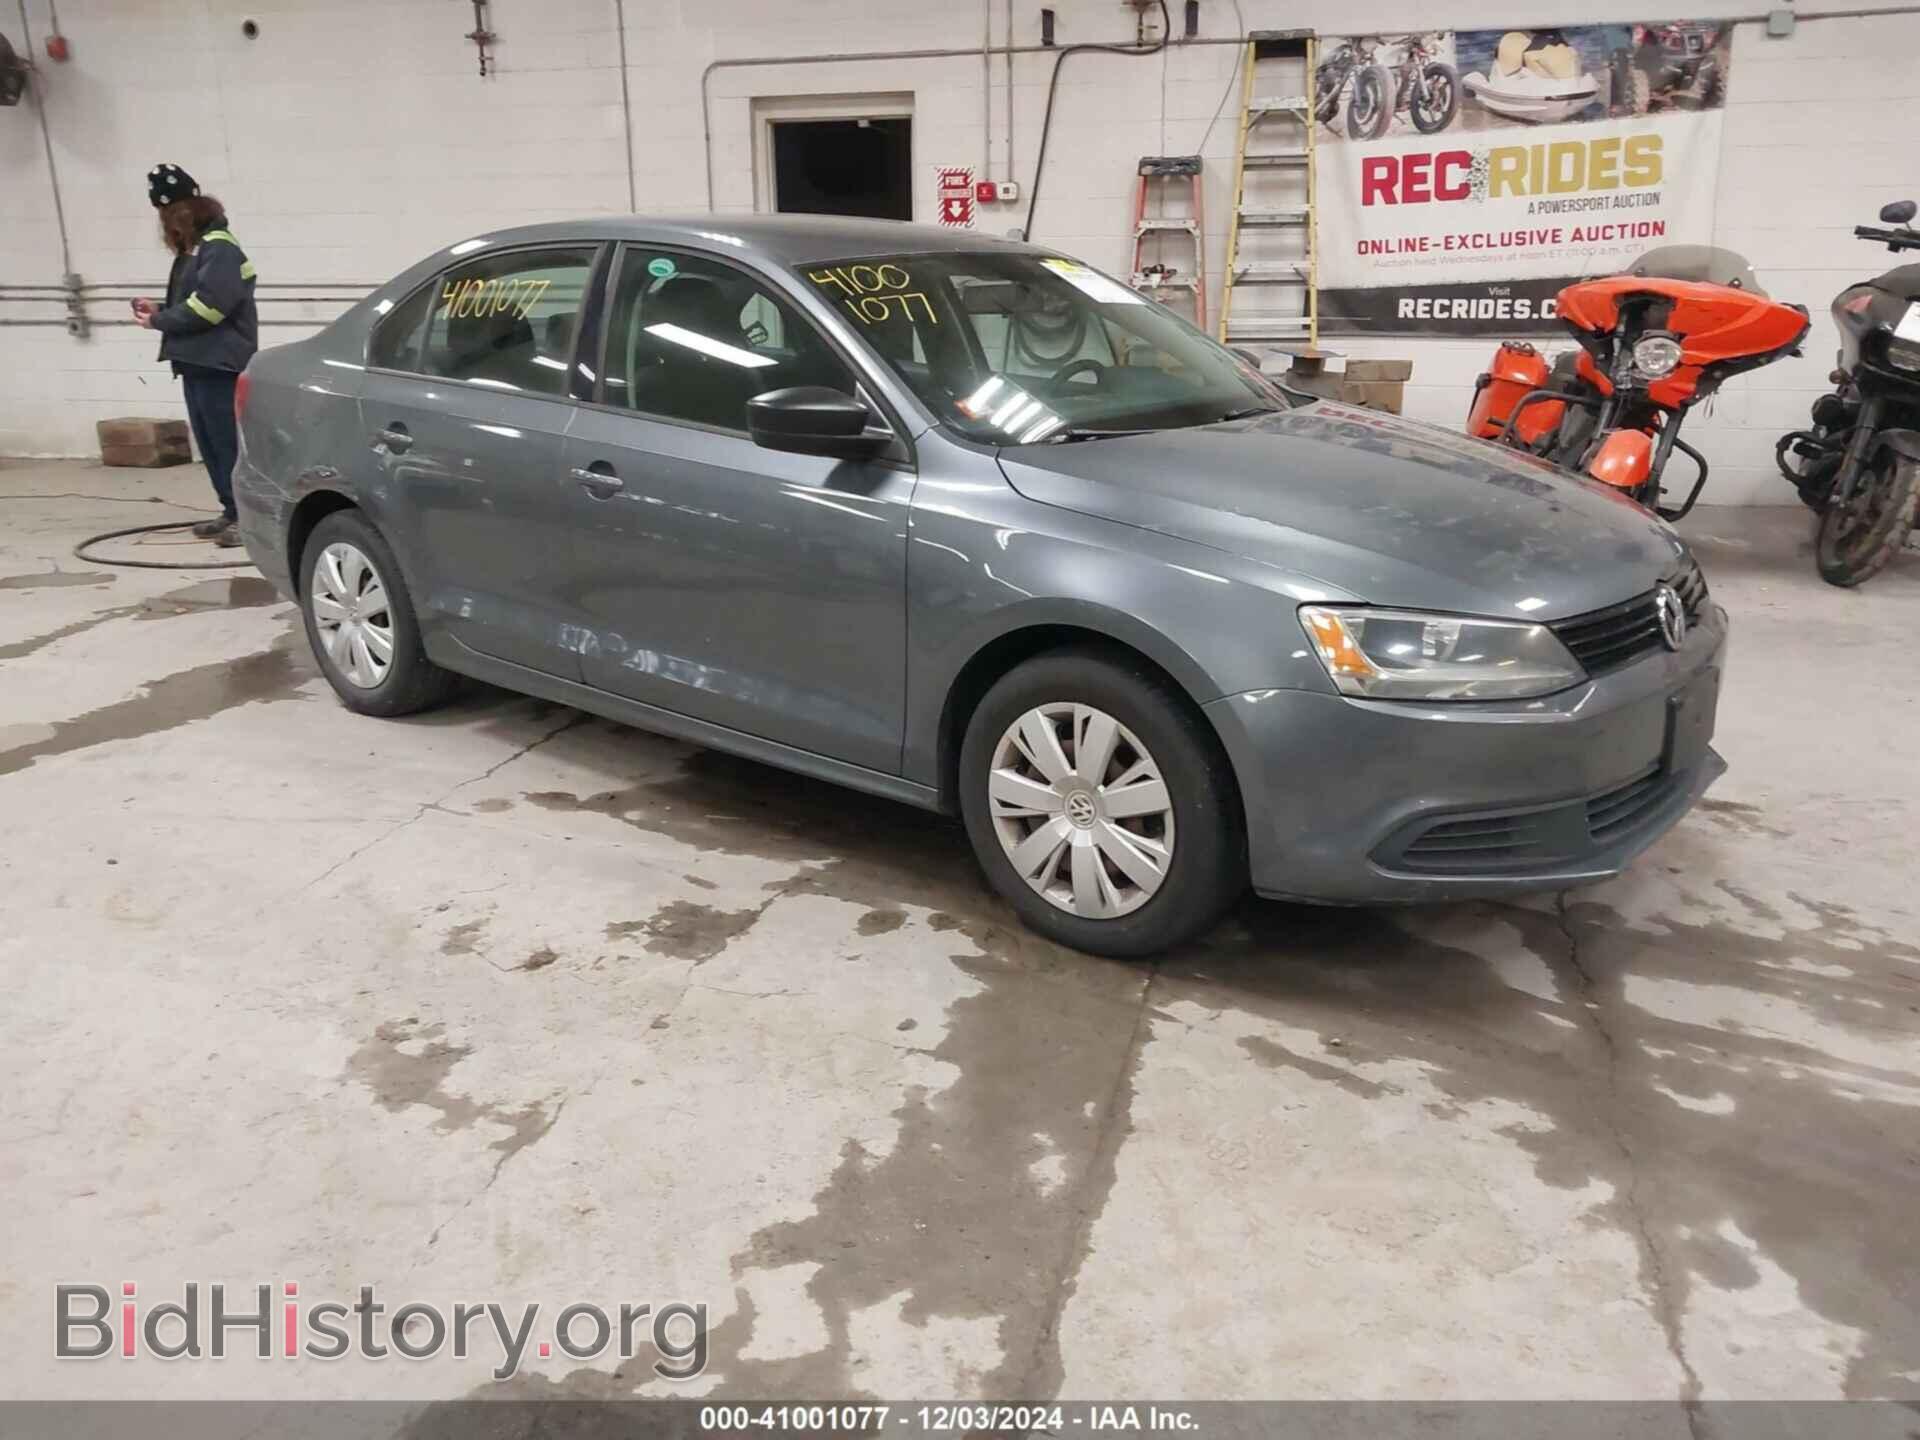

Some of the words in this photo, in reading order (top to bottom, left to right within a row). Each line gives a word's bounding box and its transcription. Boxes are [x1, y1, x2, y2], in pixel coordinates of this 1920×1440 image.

[944, 175, 966, 186] FIRE
[1361, 150, 1472, 206] REC
[1489, 134, 1664, 198] RIDES
[1528, 201, 1535, 215] A
[1538, 196, 1610, 214] POWERSPORT
[1613, 192, 1661, 209] AUCTION
[1357, 228, 1563, 255] ONLINE-EXCLUSIVE
[1571, 221, 1665, 242] AUCTION
[808, 264, 910, 296] 4100
[1488, 287, 1511, 296] Visit
[442, 279, 551, 320] 41001077
[844, 292, 937, 325] 1077
